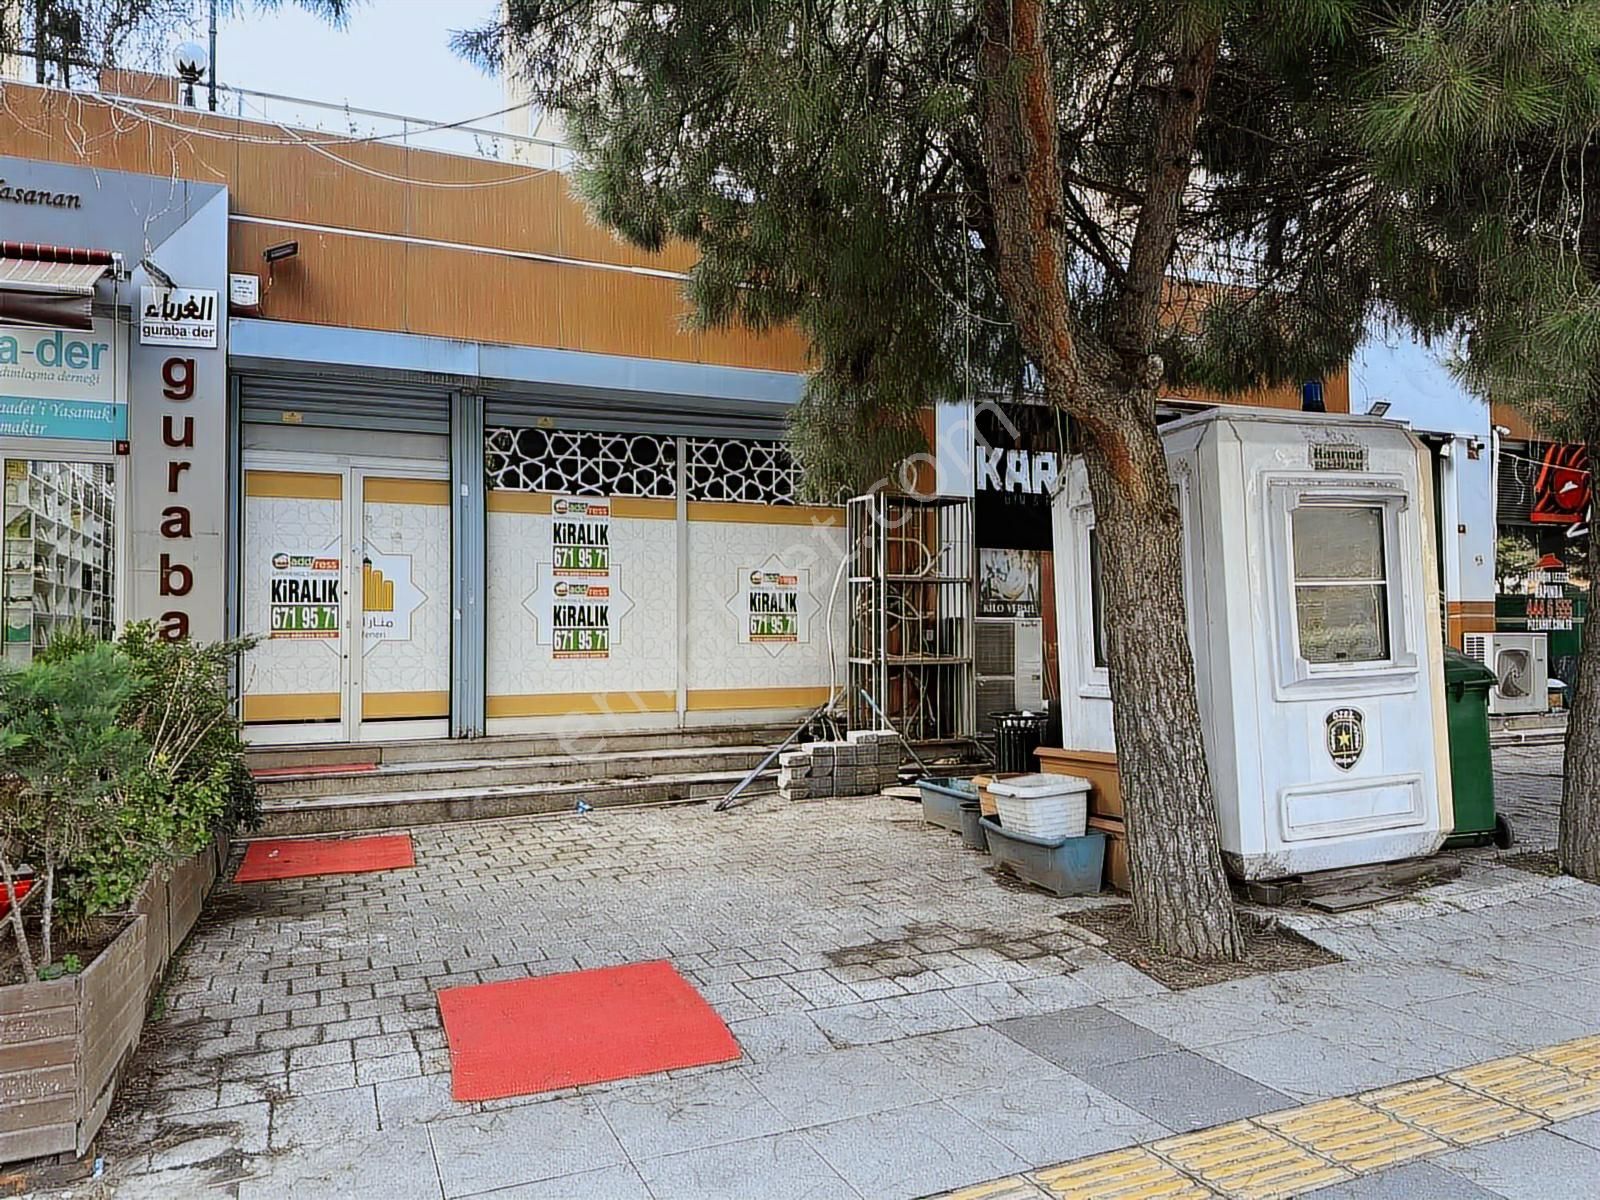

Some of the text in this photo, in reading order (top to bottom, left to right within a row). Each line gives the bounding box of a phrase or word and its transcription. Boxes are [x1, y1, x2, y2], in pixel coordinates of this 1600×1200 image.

[160, 356, 195, 642] guraba
[554, 548, 608, 569] 671 95 71
[272, 606, 338, 629] 671 95 71
[751, 616, 797, 634] 671 95 71
[554, 630, 608, 650] 671 95 71
